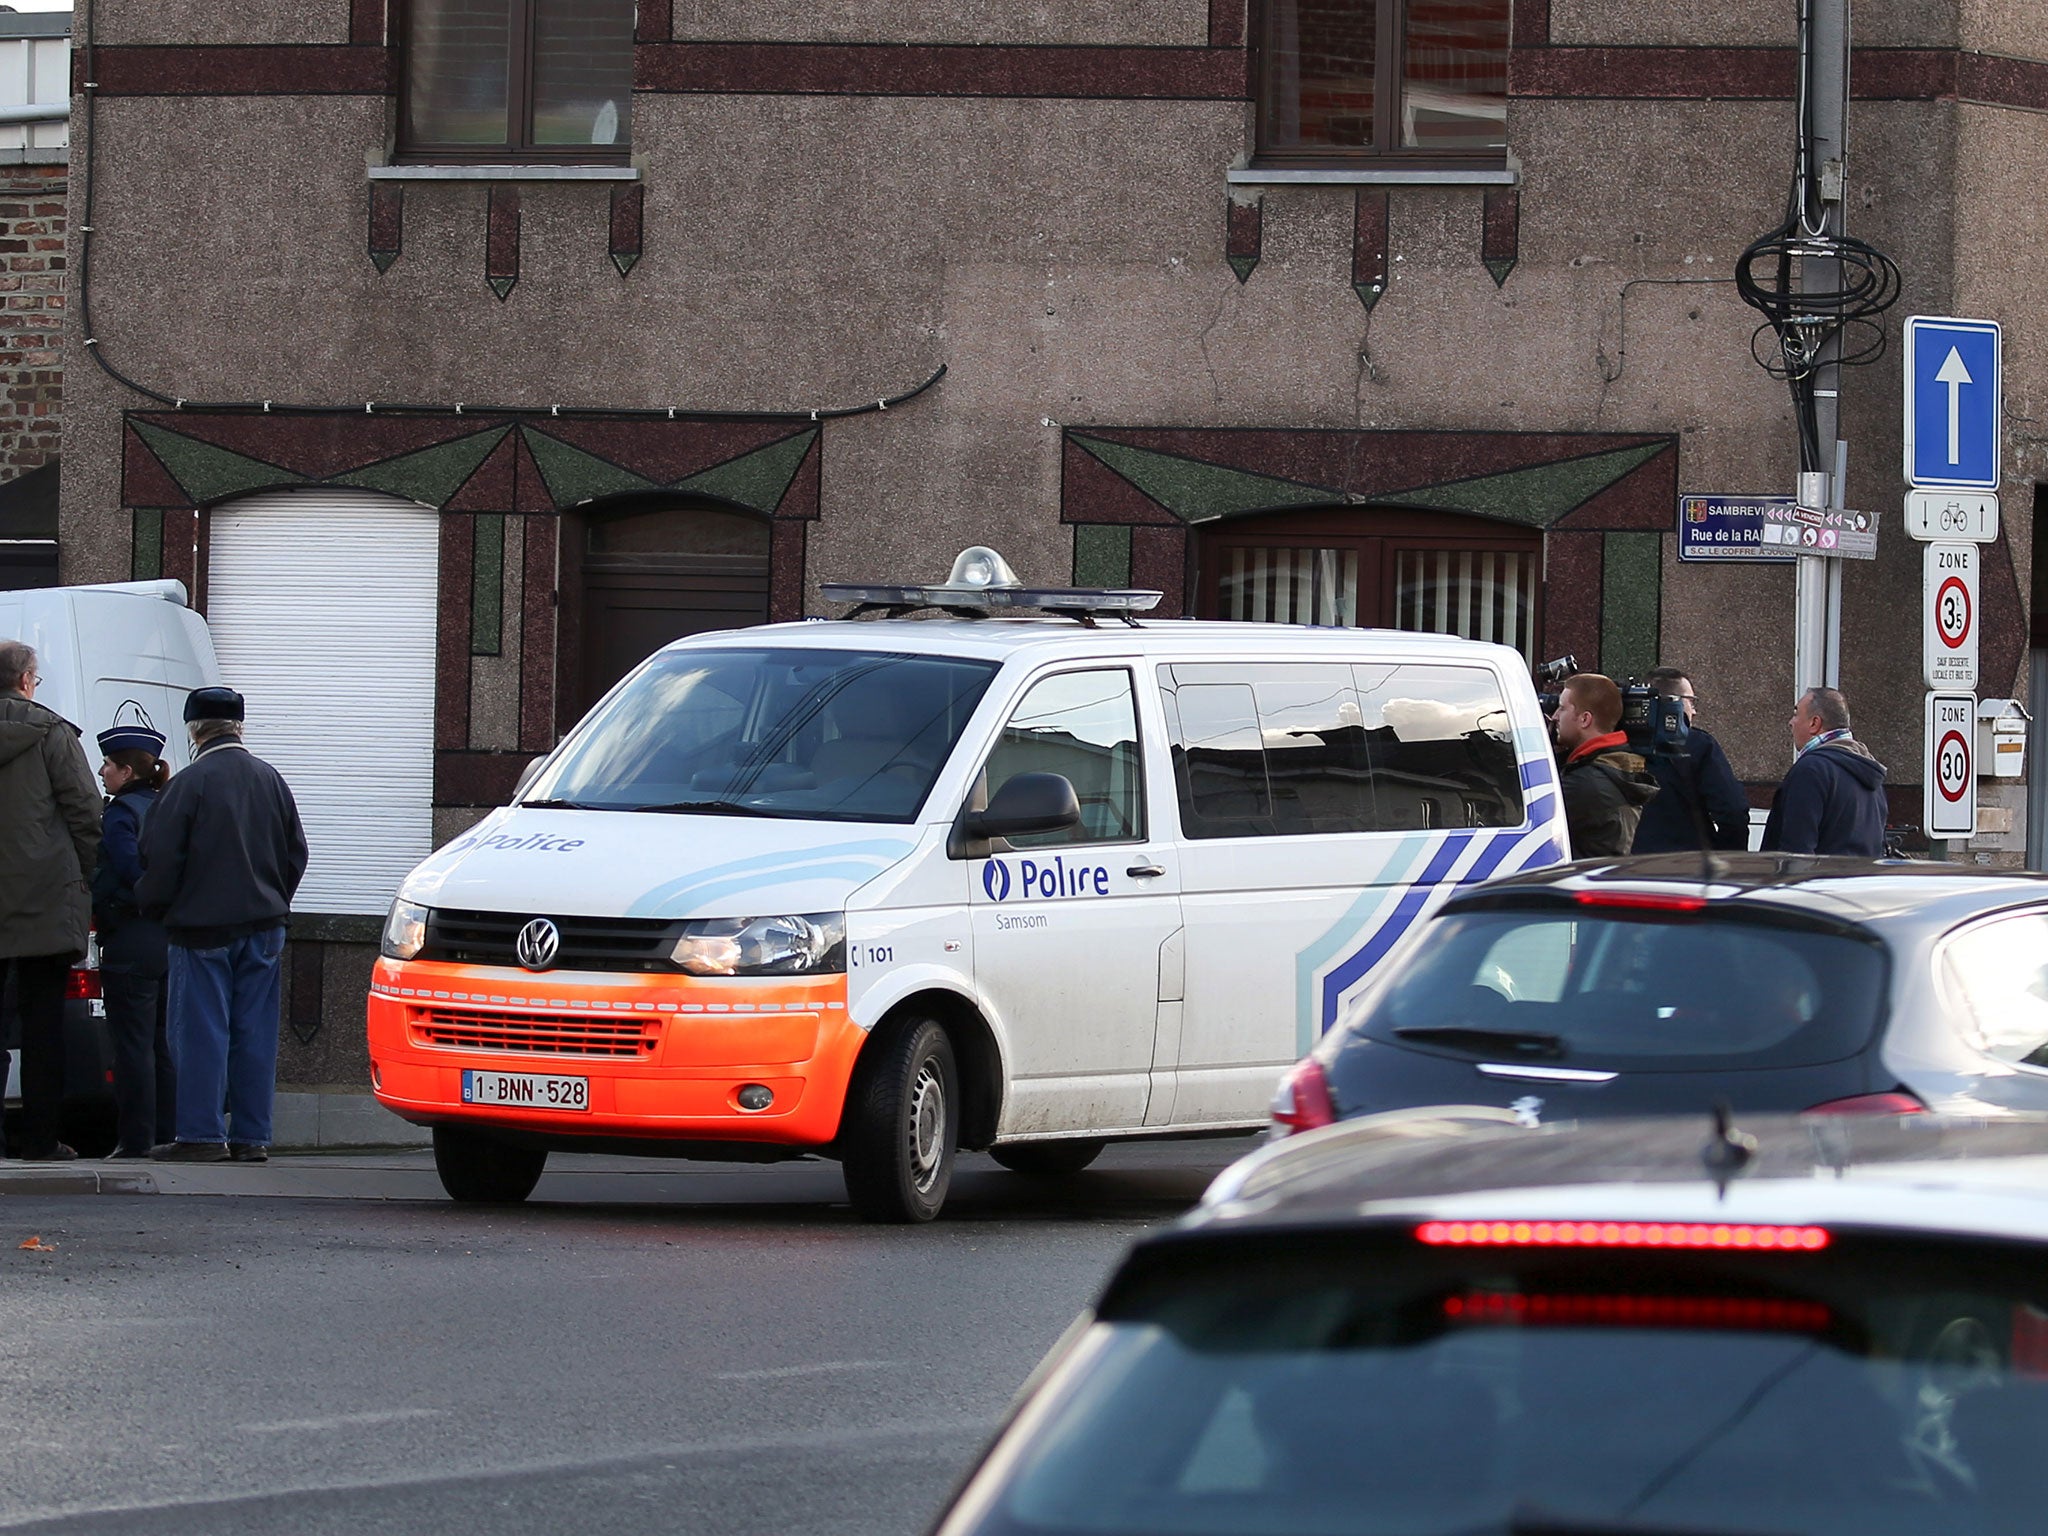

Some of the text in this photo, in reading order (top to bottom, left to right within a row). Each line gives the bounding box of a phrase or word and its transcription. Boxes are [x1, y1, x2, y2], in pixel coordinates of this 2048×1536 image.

[1692, 528, 1712, 541] Rue
[1715, 528, 1728, 541] de
[1732, 529, 1741, 541] la
[1939, 553, 1968, 568] ZONE
[1937, 657, 1969, 666] SAUF DESSERTE
[1932, 670, 1948, 679] LOCALE
[1949, 670, 1954, 679] ET
[1942, 707, 1965, 722] ZONE
[1942, 752, 1964, 780] 30
[476, 832, 585, 852] Police
[995, 914, 1048, 930] Samsom
[868, 947, 893, 963] 101
[464, 1076, 584, 1104] B 1-BNN-528
